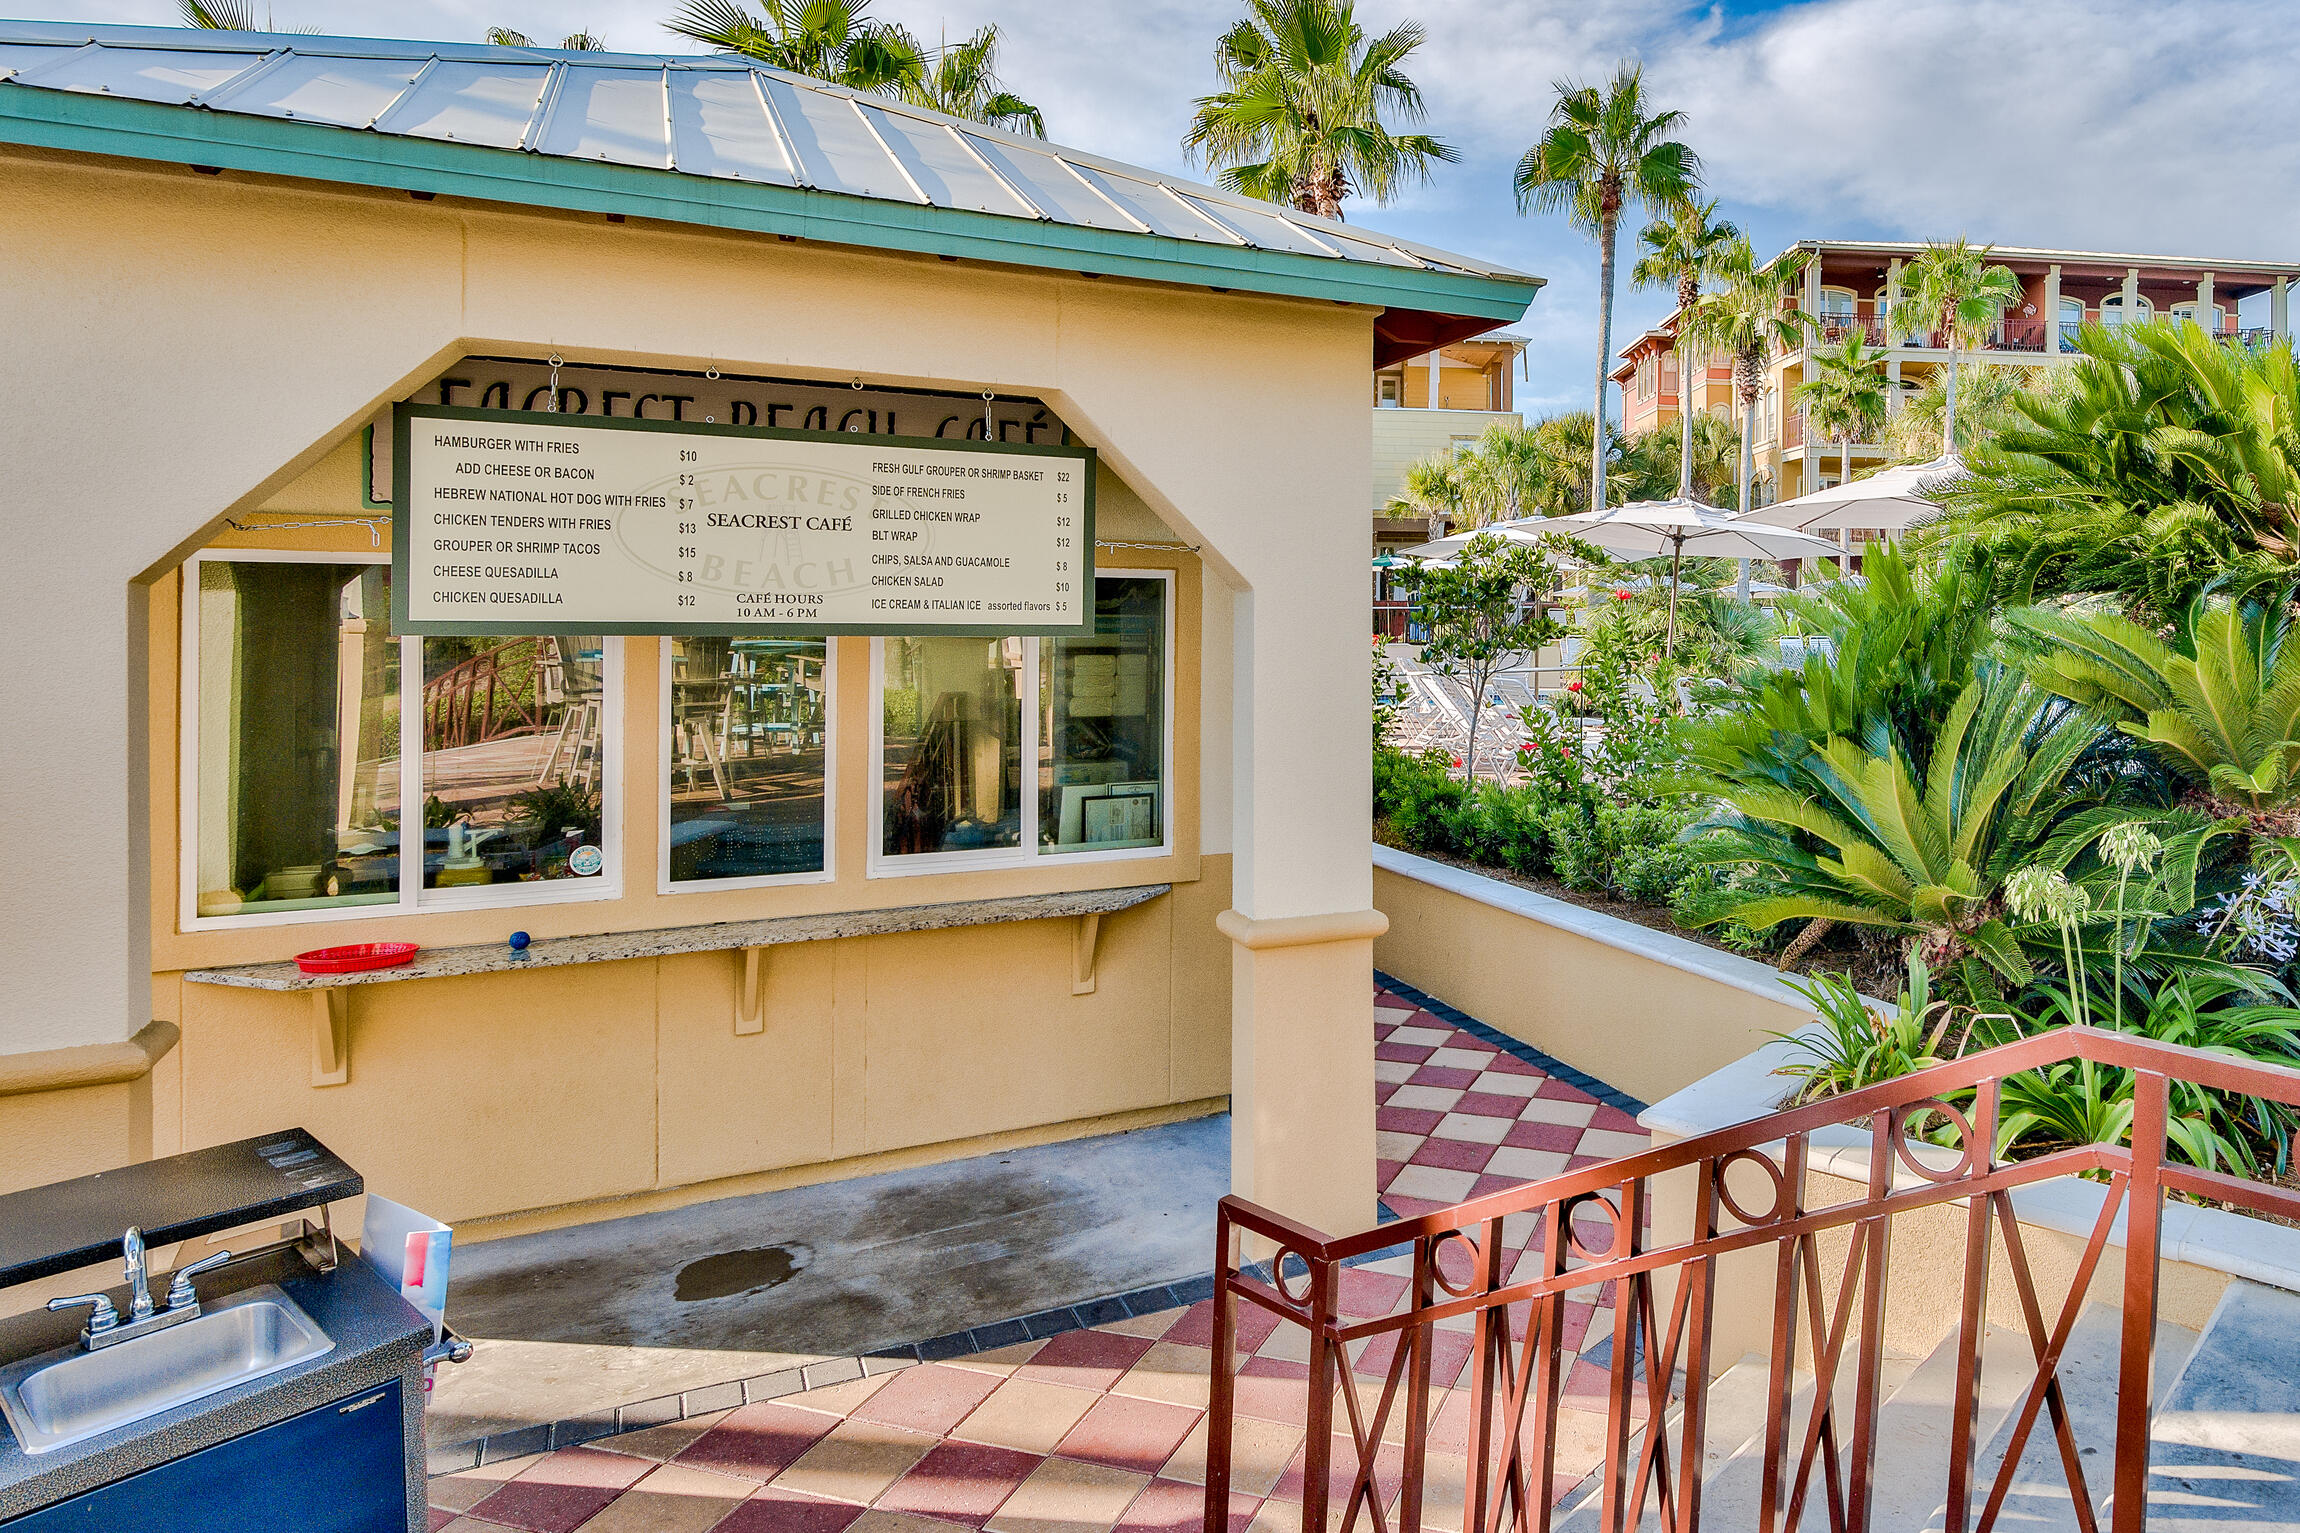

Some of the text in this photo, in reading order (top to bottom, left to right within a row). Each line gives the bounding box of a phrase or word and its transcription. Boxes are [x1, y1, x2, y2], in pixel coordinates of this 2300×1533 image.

[434, 435, 580, 454] HAMBURGER WITH FRIES
[680, 450, 697, 462] $10
[455, 462, 594, 480] ADD CHEESE OR BACON
[872, 462, 1044, 481] FRESH GULF GROUPER OR SHRIMP BASKET
[1057, 472, 1070, 482] $22
[434, 487, 666, 508] HEBREW NATIONAL HOT DOG WITH FRIES
[872, 485, 965, 500] SIDE OF FRENCH FRIES
[434, 513, 611, 530] CHICKEN TENDERS WITH FRIES
[706, 512, 852, 532] SEACREST CAFÉ
[872, 508, 981, 523] GRILLED CHICKEN WRAP
[1056, 516, 1070, 527] $12
[679, 522, 696, 535] $13
[872, 530, 918, 542] BLT WRAP
[1056, 537, 1070, 548] $12
[434, 539, 600, 555] GROUPER OR SHRIMP TACOS
[678, 546, 696, 559] $15
[872, 554, 1010, 568] CHIPS, SALSA AND GUACAMOLE
[433, 565, 559, 579] CHEESE QUESADILLA
[699, 553, 856, 590] BEACH
[872, 575, 944, 587] CHICKEN SALAD
[1056, 582, 1070, 592] $10
[433, 591, 563, 604] CHICKEN QUESADILLA
[678, 594, 696, 607] $12
[736, 592, 824, 604] CAFÉ HOURS
[871, 598, 1050, 611] ICE CREAM & ITALIAN ICE assorted flavors
[737, 608, 751, 617] 10
[754, 608, 775, 618] AM
[786, 608, 794, 618] 6
[797, 608, 817, 618] PM
